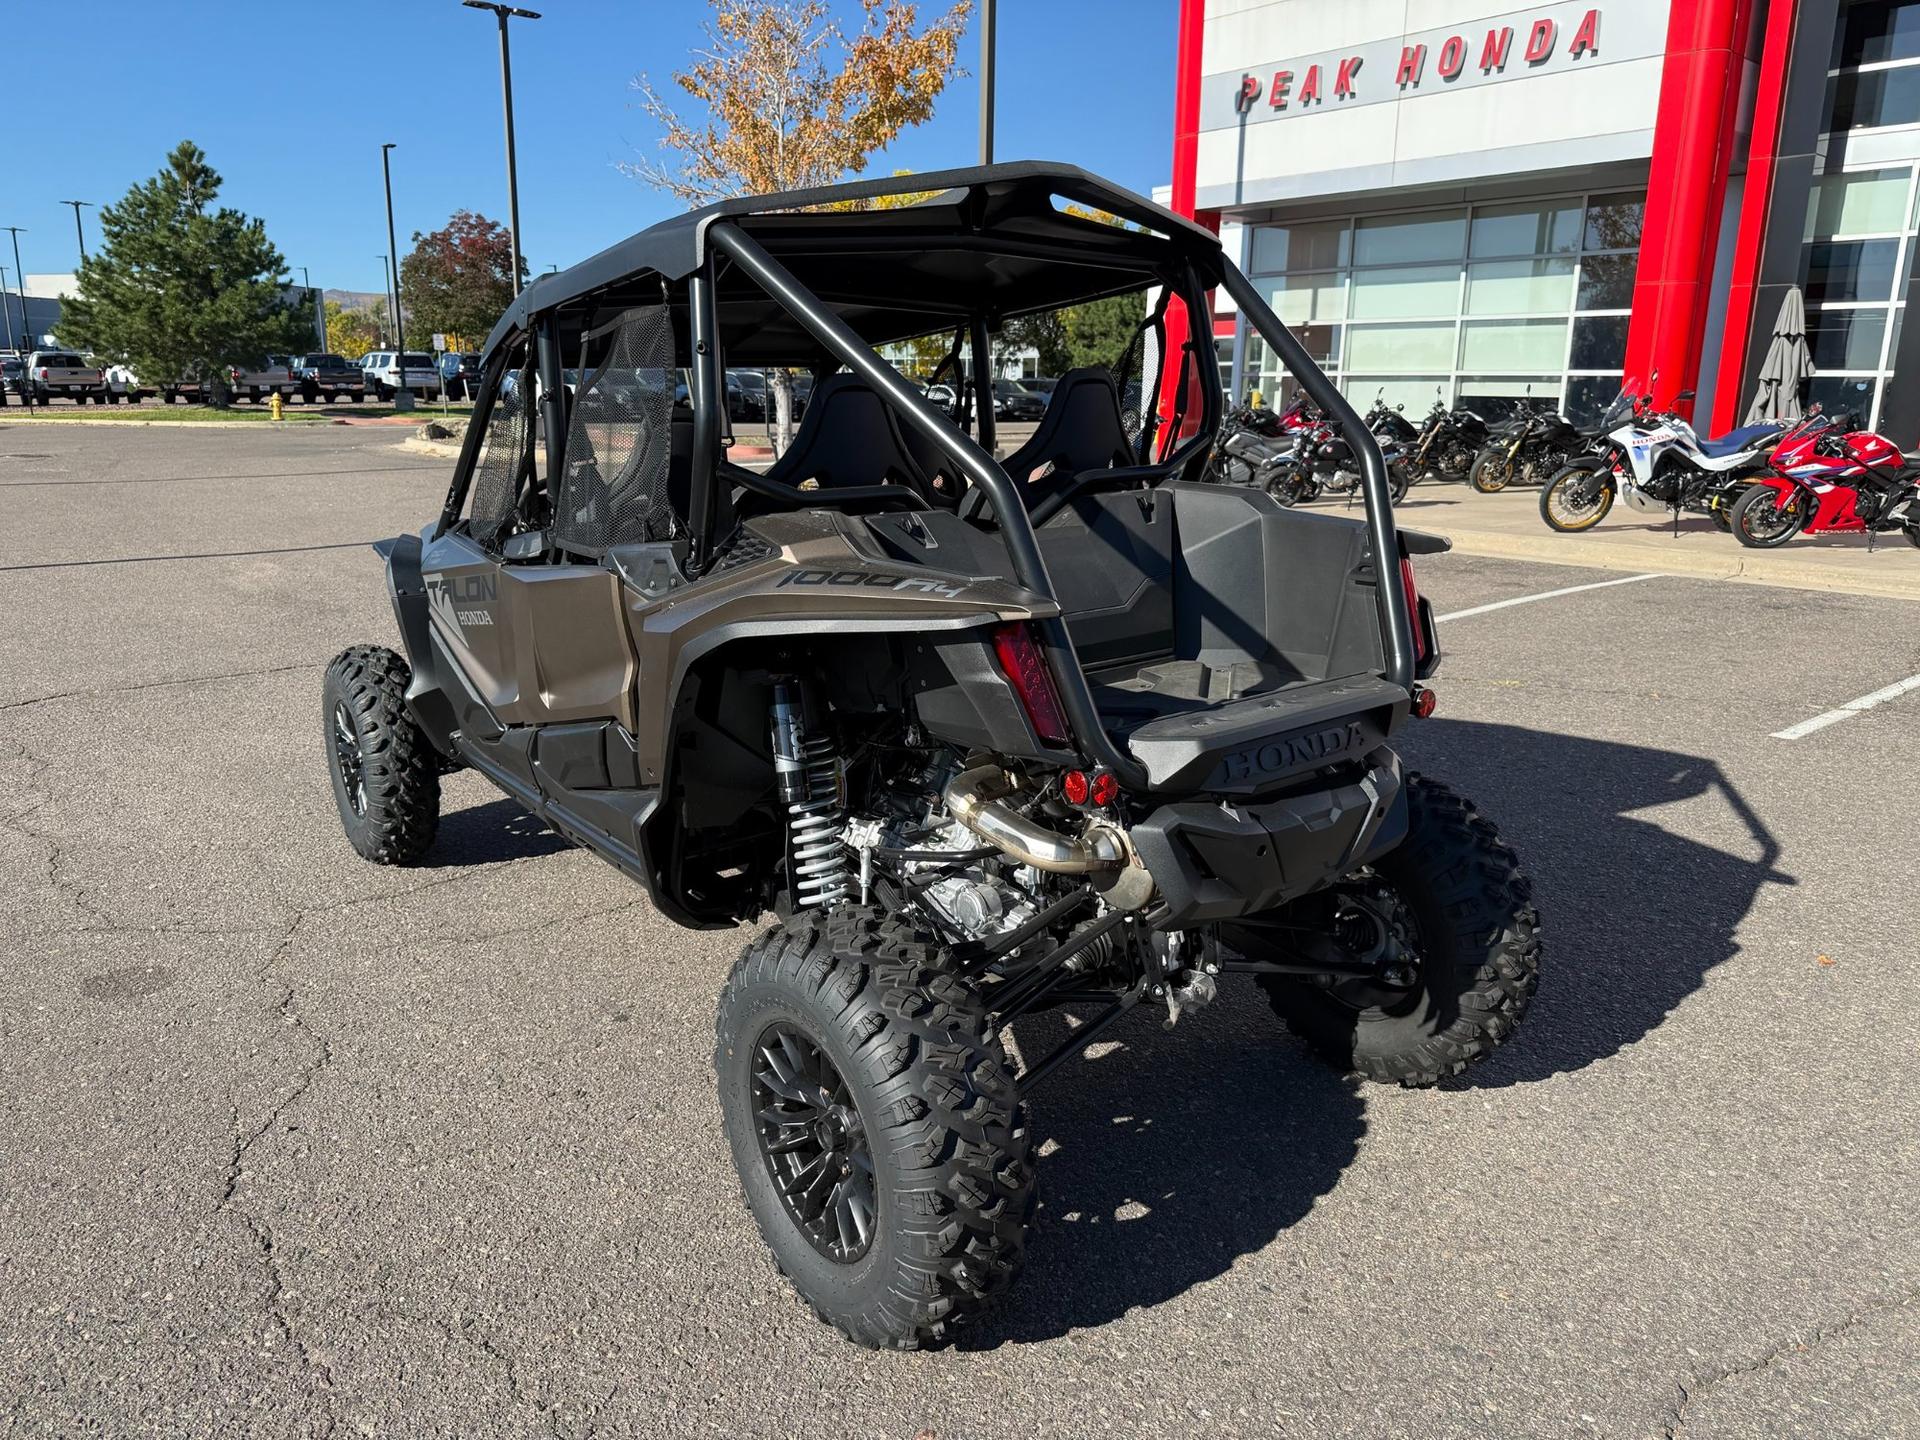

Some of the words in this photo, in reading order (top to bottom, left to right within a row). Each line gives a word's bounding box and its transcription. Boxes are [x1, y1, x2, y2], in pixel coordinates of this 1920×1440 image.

[1239, 56, 1363, 113] PEAK
[1395, 9, 1602, 90] HONDA
[1632, 433, 1672, 446] HONDA
[423, 573, 497, 607] TALON
[457, 610, 493, 625] HONDA
[1223, 721, 1364, 782] HONDA
